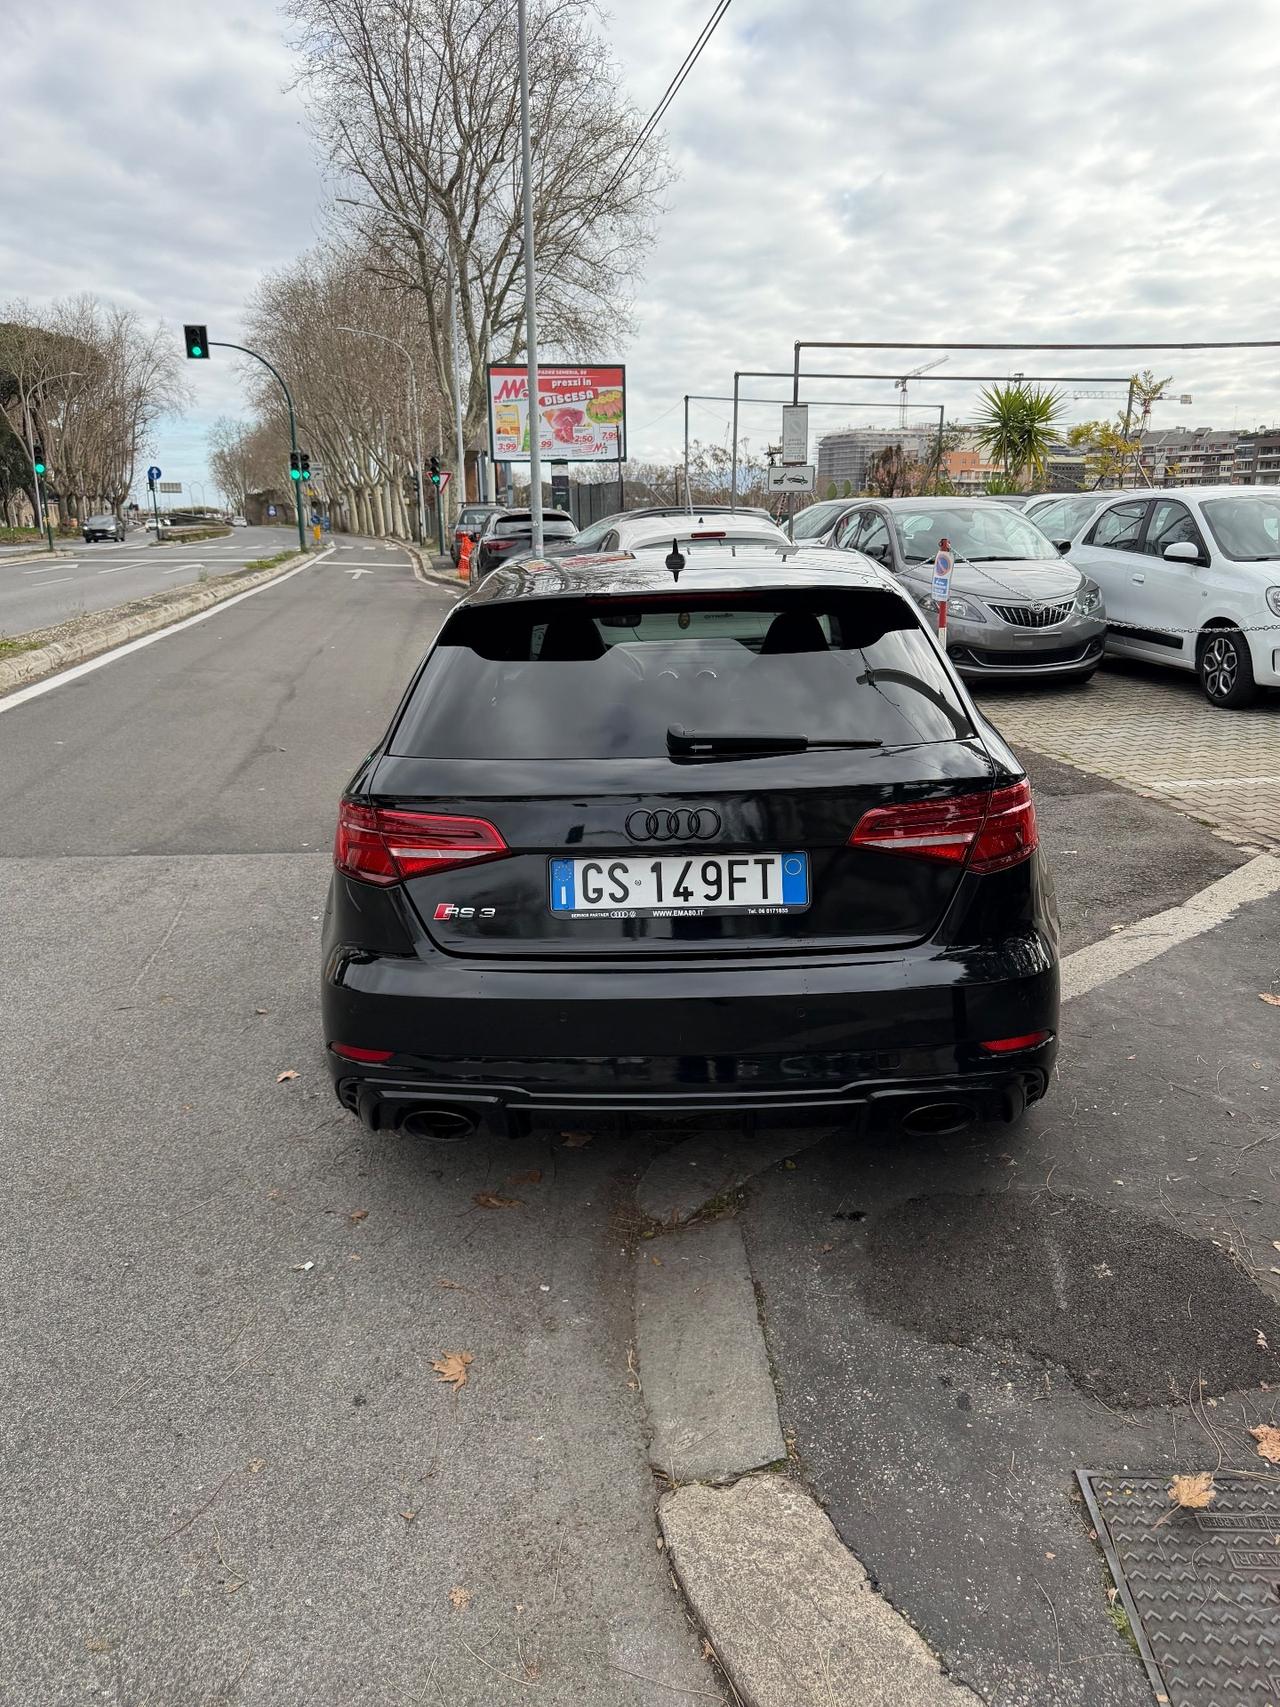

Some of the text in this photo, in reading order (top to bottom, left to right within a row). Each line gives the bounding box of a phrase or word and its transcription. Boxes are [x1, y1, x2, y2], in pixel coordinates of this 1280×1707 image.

[551, 378, 592, 389] prezzi in
[544, 390, 594, 406] DISCESA
[582, 858, 775, 904] GS 149FT
[441, 906, 496, 918] RS 3
[1231, 1553, 1280, 1566] AFORI
